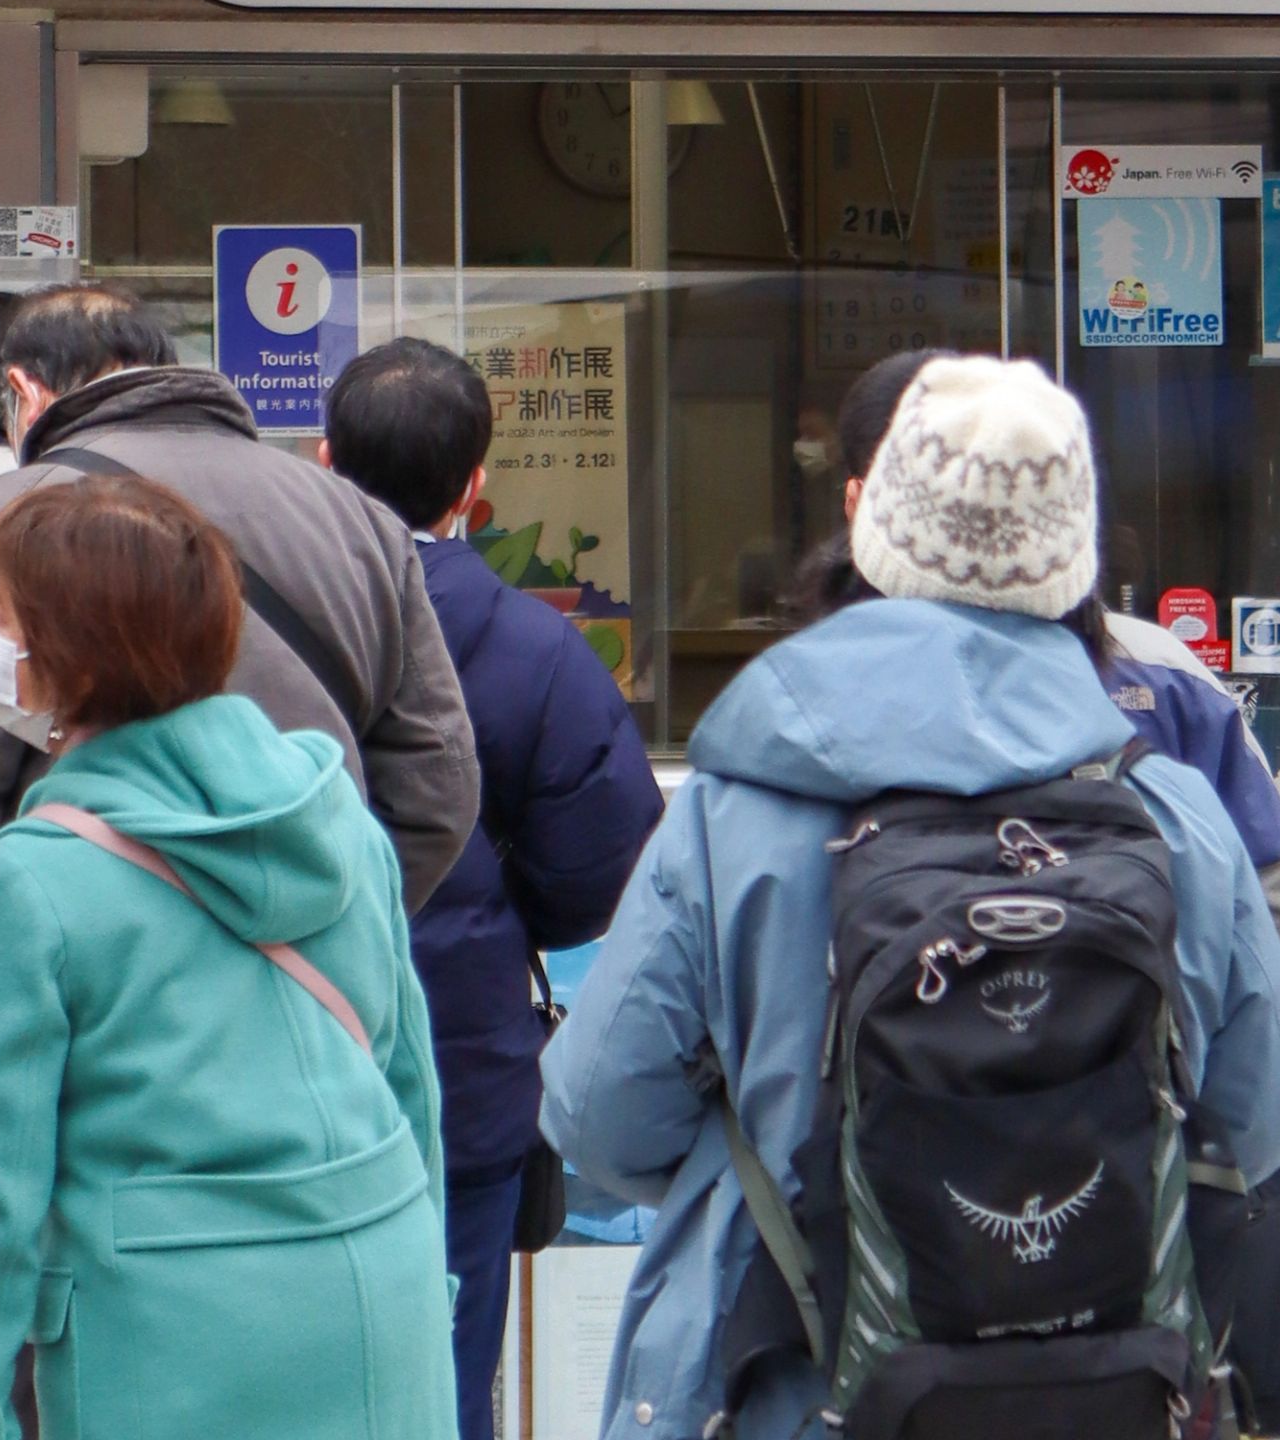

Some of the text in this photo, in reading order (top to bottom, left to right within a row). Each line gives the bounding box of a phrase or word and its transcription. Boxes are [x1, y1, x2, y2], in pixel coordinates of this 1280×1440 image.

[1122, 167, 1163, 182] Japan.
[1166, 167, 1193, 180] Free
[258, 350, 321, 368] Tourist
[233, 373, 335, 390] Informatio
